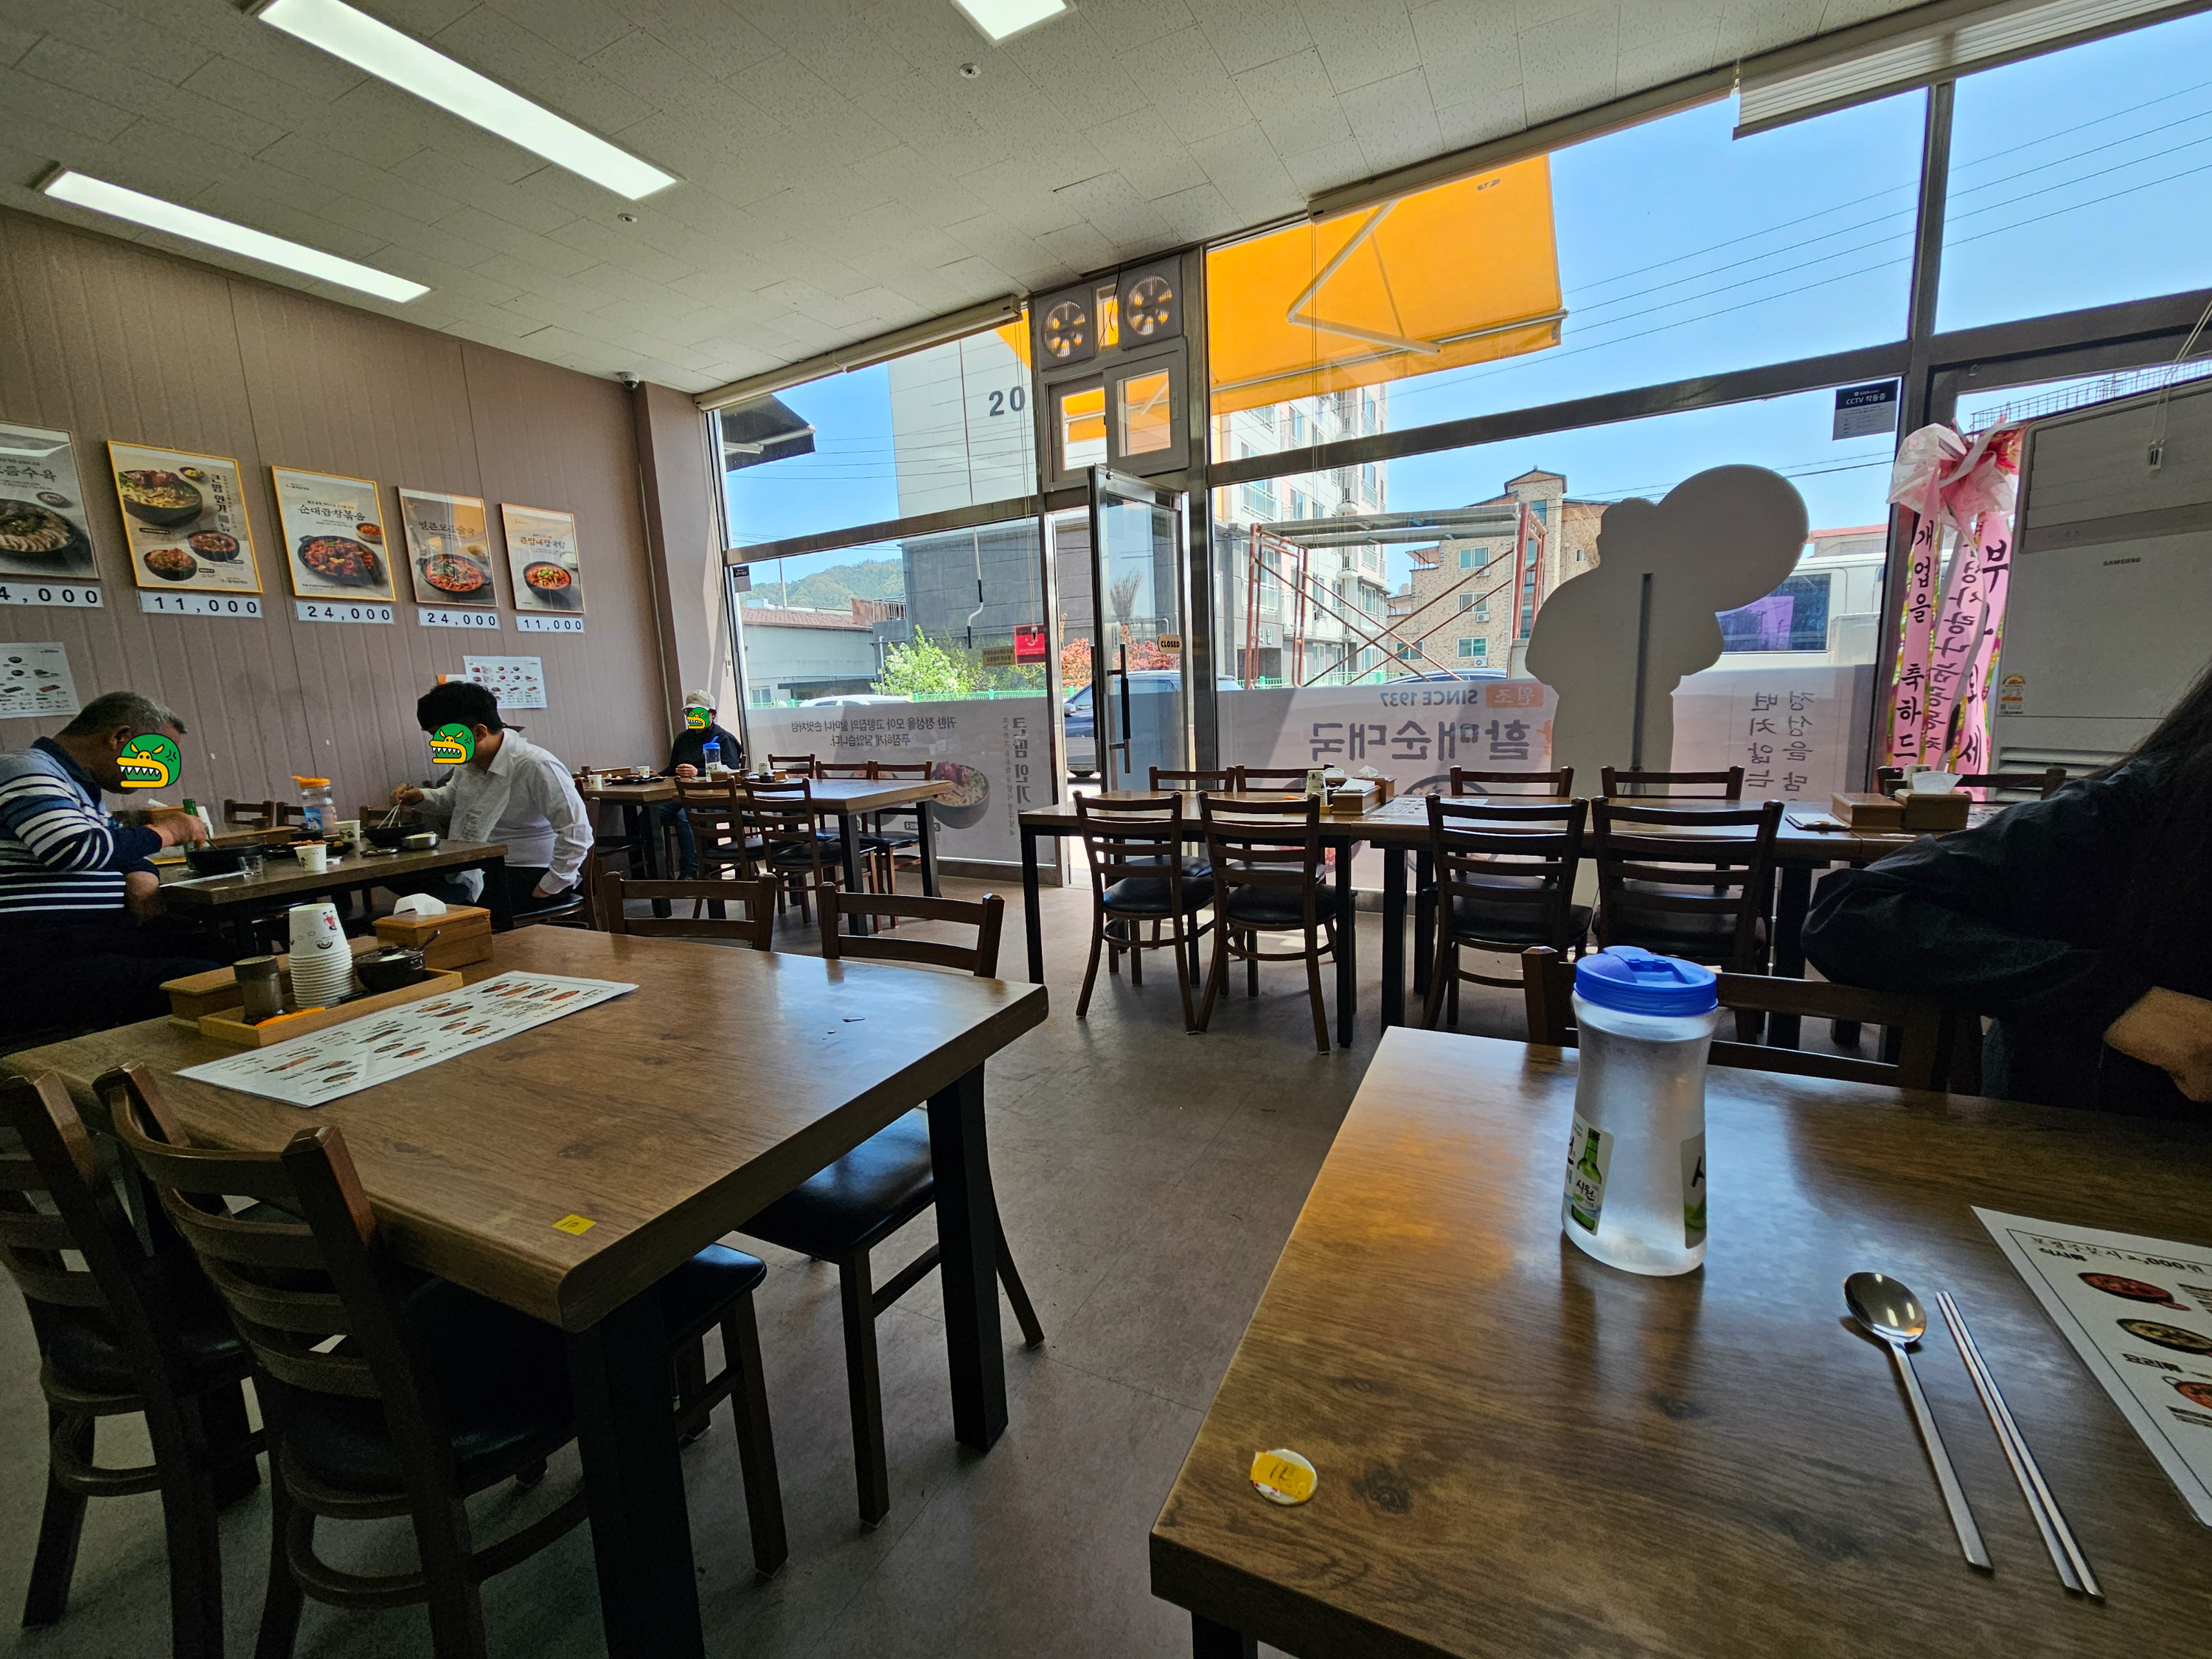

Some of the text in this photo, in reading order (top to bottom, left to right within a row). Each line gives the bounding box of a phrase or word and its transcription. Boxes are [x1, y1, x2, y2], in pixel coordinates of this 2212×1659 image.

[989, 386, 1026, 417] 20
[1846, 393, 1886, 405] CCTV 작동중
[0, 465, 57, 482] 듬수육
[298, 504, 366, 521] 순대곱창볶음
[2103, 557, 2141, 566] SAMSUNG
[155, 597, 257, 613] 11,000
[307, 605, 390, 620] 24,000
[428, 613, 495, 626] 24,000
[524, 619, 581, 630] 11,000
[1161, 640, 1180, 648] CLOSED
[1893, 520, 1934, 773] 개업을 축하드
